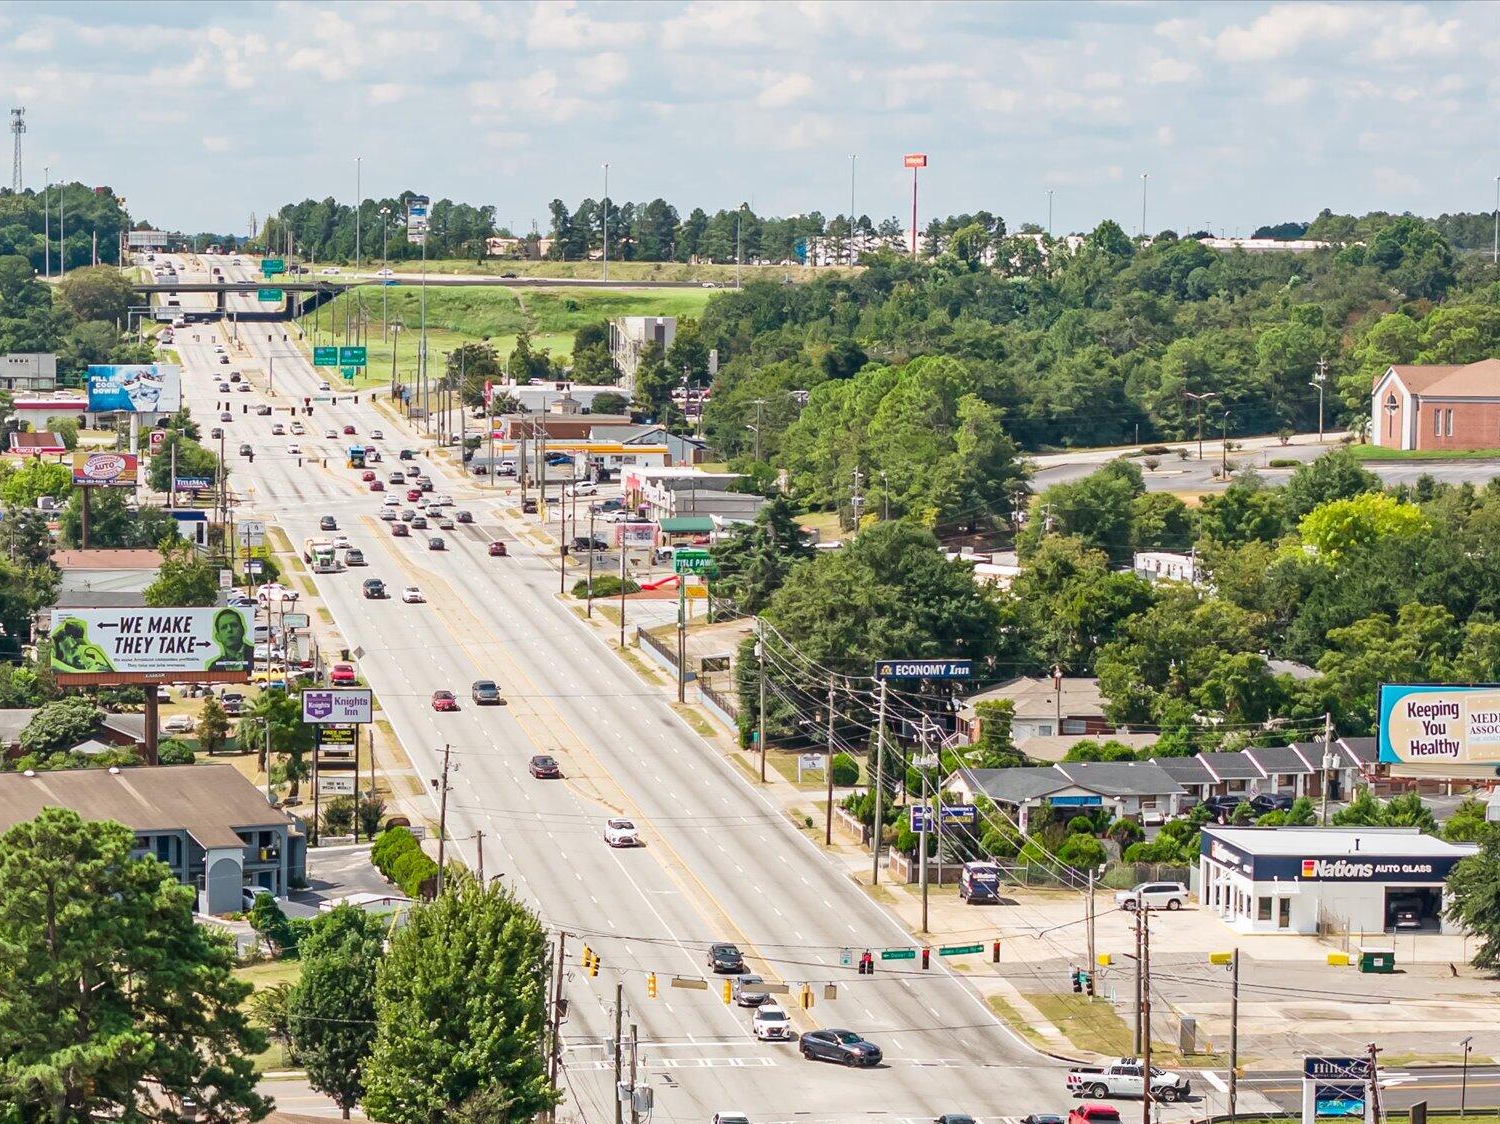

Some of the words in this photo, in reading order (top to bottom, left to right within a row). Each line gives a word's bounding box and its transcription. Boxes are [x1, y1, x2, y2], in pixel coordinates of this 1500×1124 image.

[94, 461, 115, 470] AUTO
[120, 616, 142, 633] WE
[147, 616, 193, 633] MAKE
[115, 637, 155, 654] THEY
[159, 636, 196, 653] TAKE
[895, 665, 946, 675] ECONOMY
[949, 665, 970, 675] Inn
[334, 697, 368, 707] Knights
[1407, 700, 1459, 720] Keeping
[344, 707, 358, 716] Inn
[1423, 720, 1446, 735] You
[1410, 739, 1460, 757] Healthy
[1314, 859, 1373, 878] Nations
[1375, 864, 1400, 873] AUTO
[1402, 864, 1432, 873] GLASS
